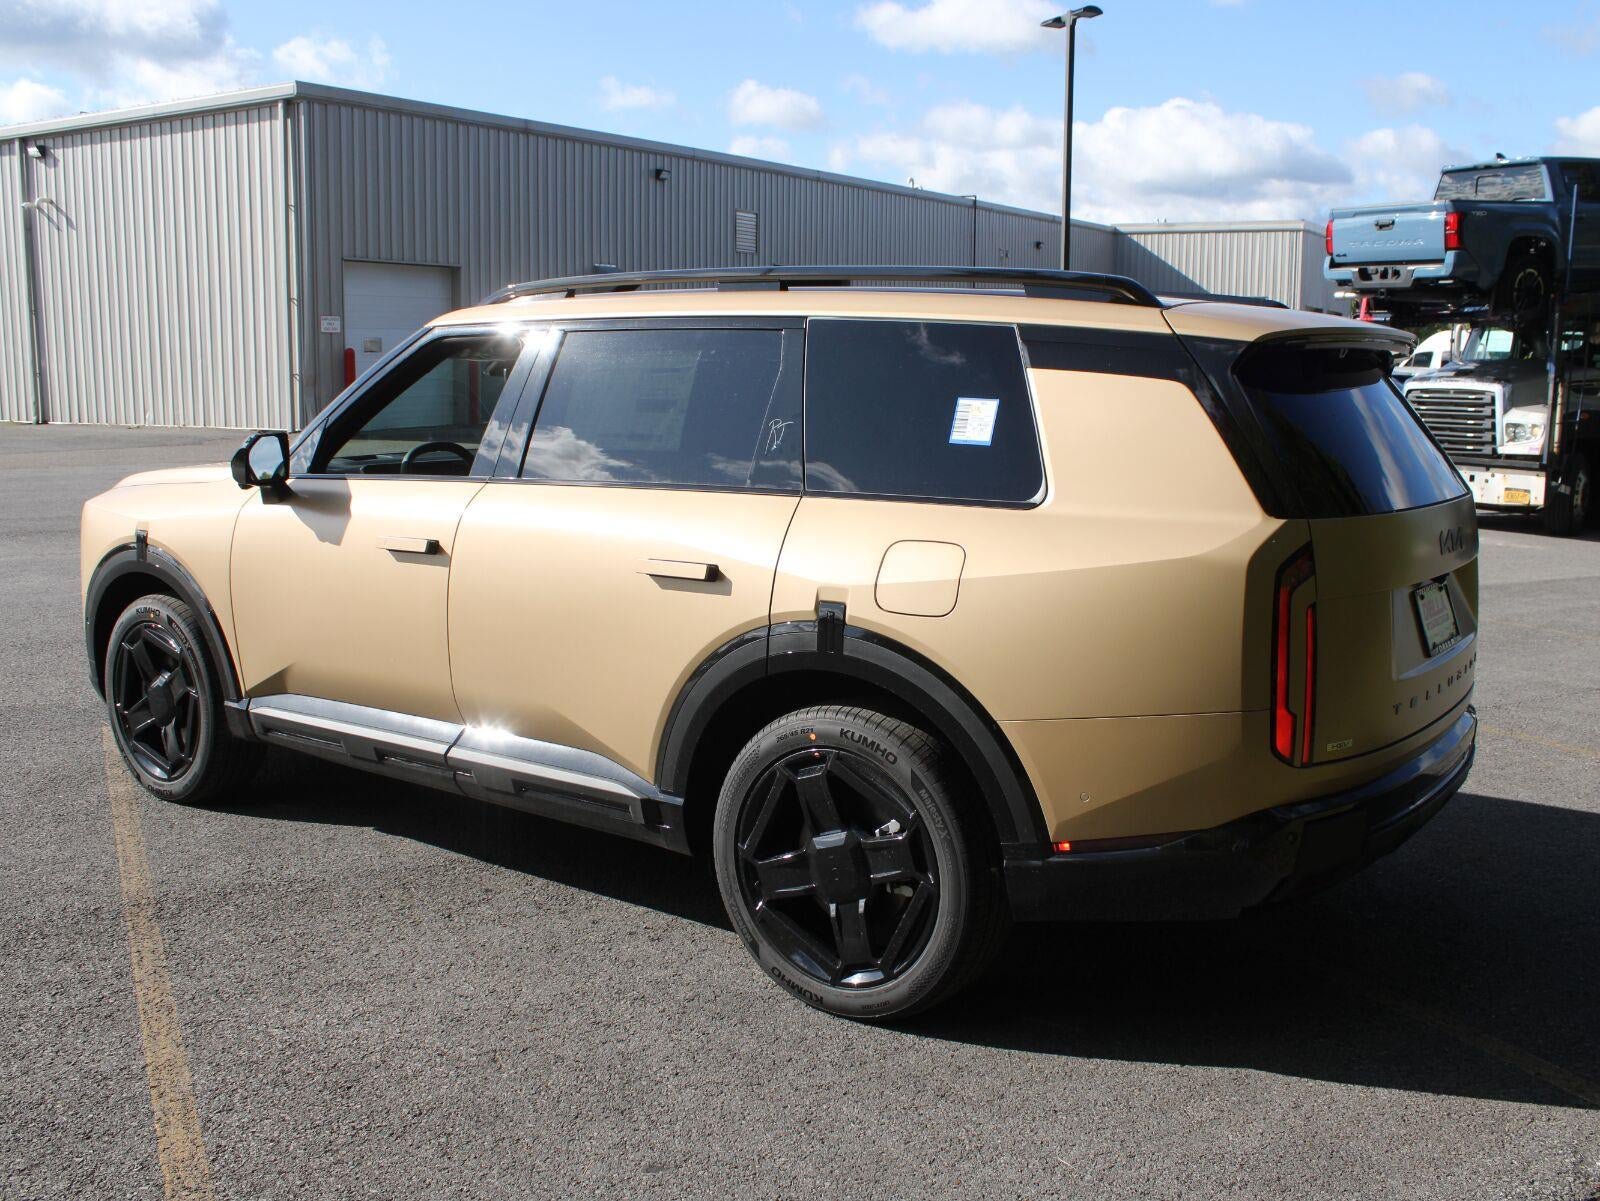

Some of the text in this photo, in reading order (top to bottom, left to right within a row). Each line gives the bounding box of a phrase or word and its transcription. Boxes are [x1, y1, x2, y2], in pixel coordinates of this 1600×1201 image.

[1348, 238, 1425, 249] TACOMA
[135, 606, 161, 618] KUMHO
[839, 727, 898, 765] KUMHO
[770, 965, 825, 1005] KUMHO
